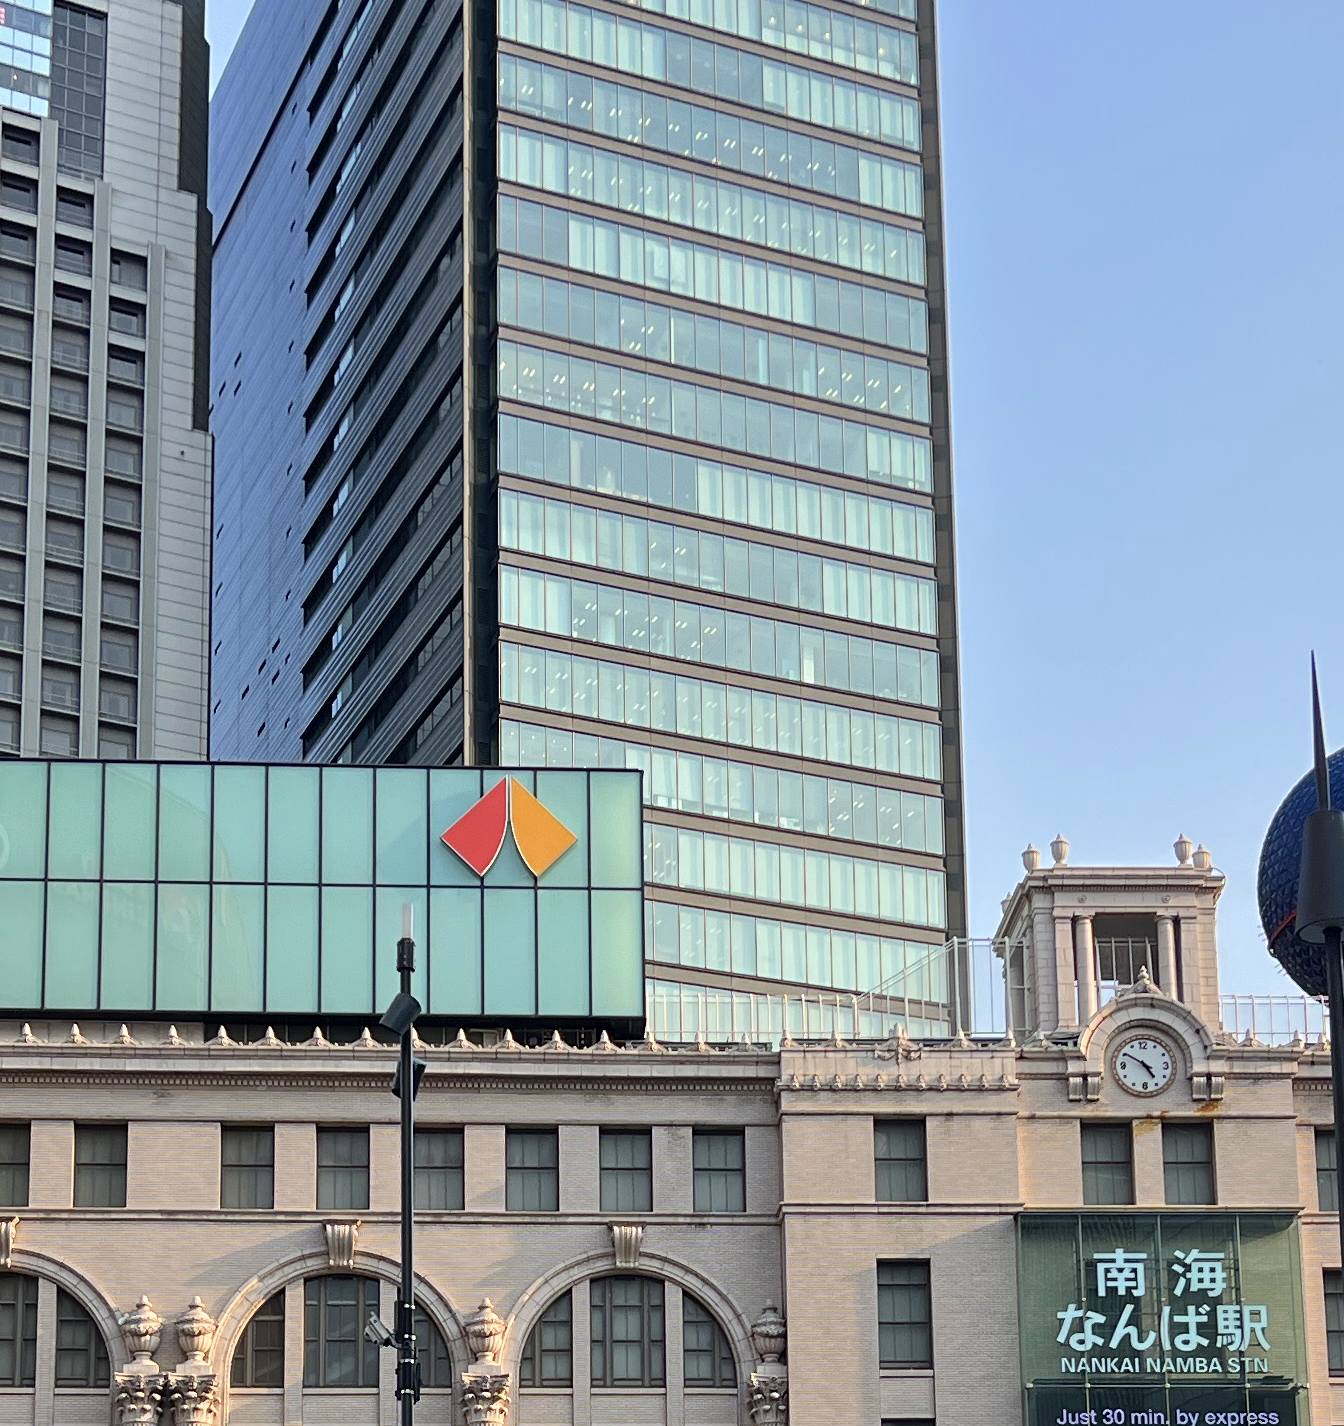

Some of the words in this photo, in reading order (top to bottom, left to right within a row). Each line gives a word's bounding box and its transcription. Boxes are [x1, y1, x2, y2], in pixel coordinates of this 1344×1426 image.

[1092, 1247, 1228, 1298] 南海
[1056, 1303, 1272, 1352] なんば駅
[1060, 1356, 1141, 1374] NANKAI
[1146, 1356, 1222, 1374] NAMBA
[1227, 1356, 1269, 1374] STN
[1056, 1409, 1098, 1426] Just
[1102, 1409, 1126, 1425] 30
